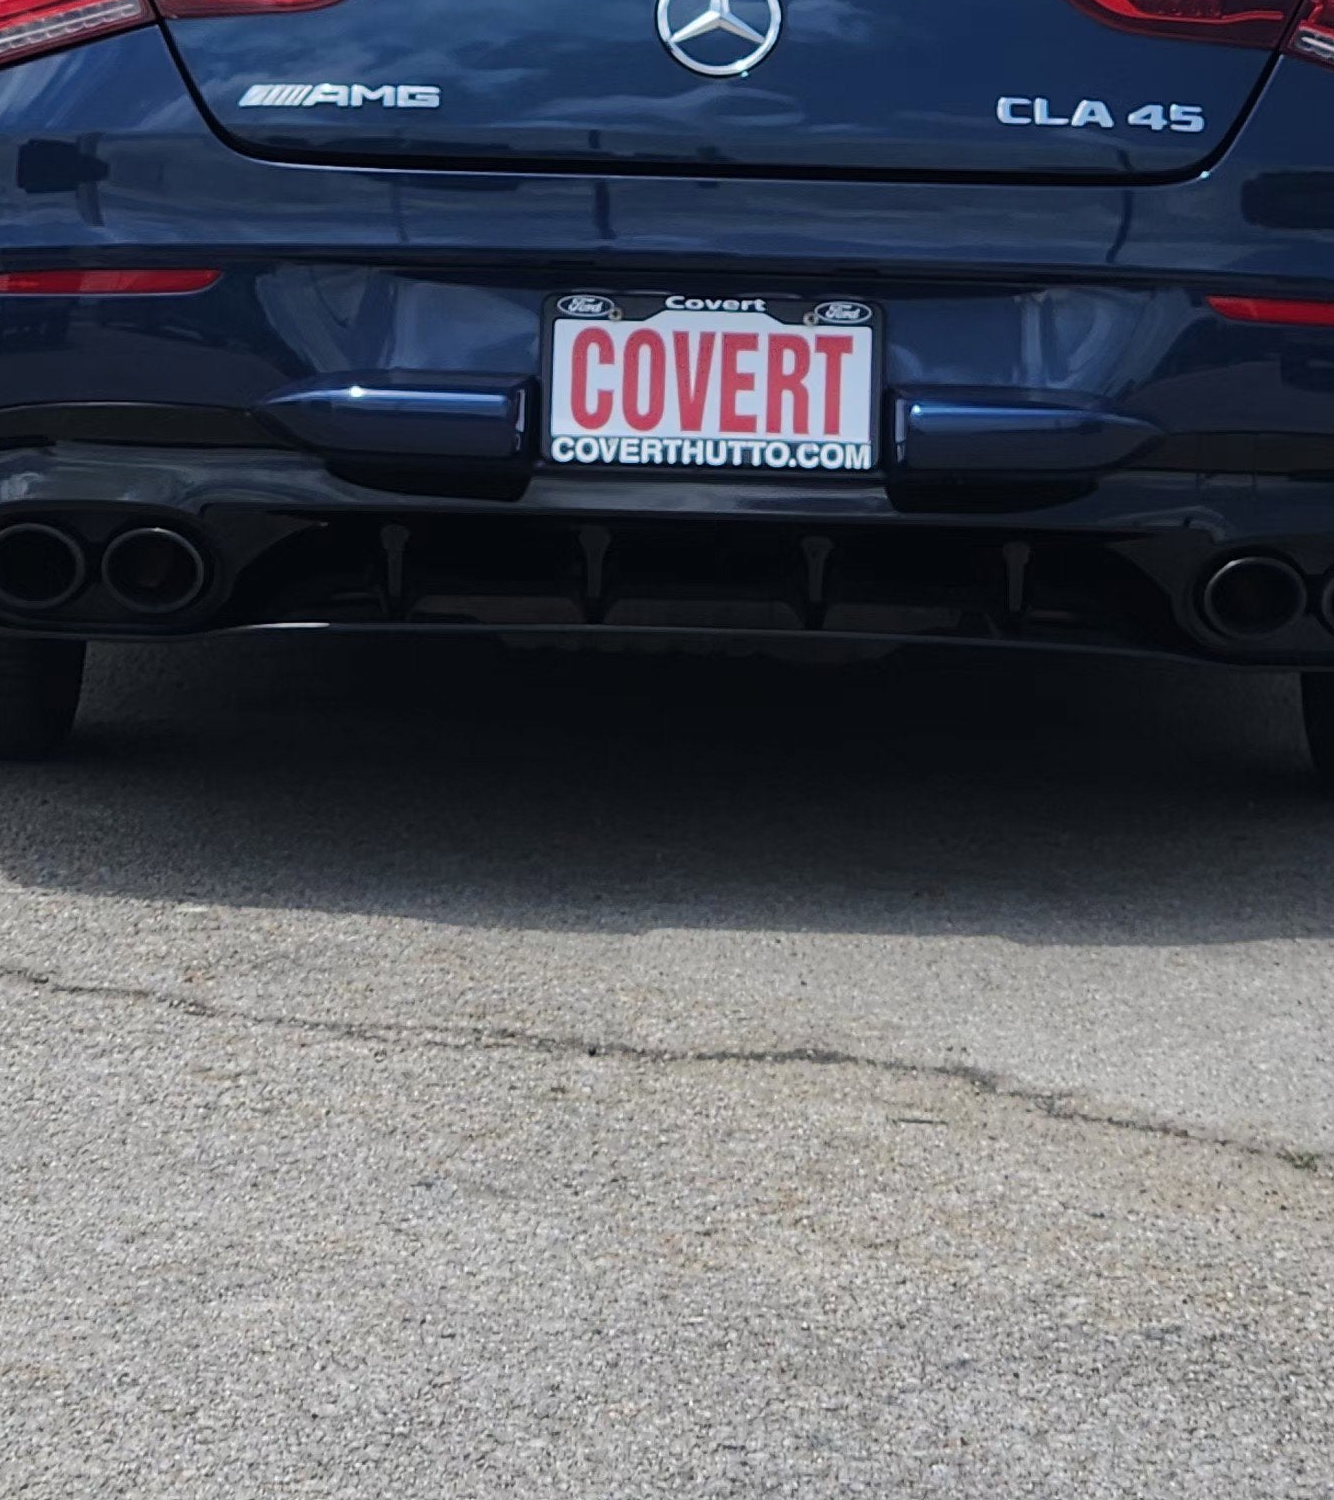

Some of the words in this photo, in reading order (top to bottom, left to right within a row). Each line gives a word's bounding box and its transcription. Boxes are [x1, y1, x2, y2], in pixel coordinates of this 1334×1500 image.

[301, 83, 441, 108] AMG
[996, 96, 1115, 128] CLA
[1127, 103, 1206, 133] 45
[567, 297, 604, 313] Ford
[664, 295, 767, 312] Covert
[825, 303, 861, 319] Ford
[570, 326, 854, 436] COVERT
[551, 436, 872, 470] COVERTHUTTO.COM
